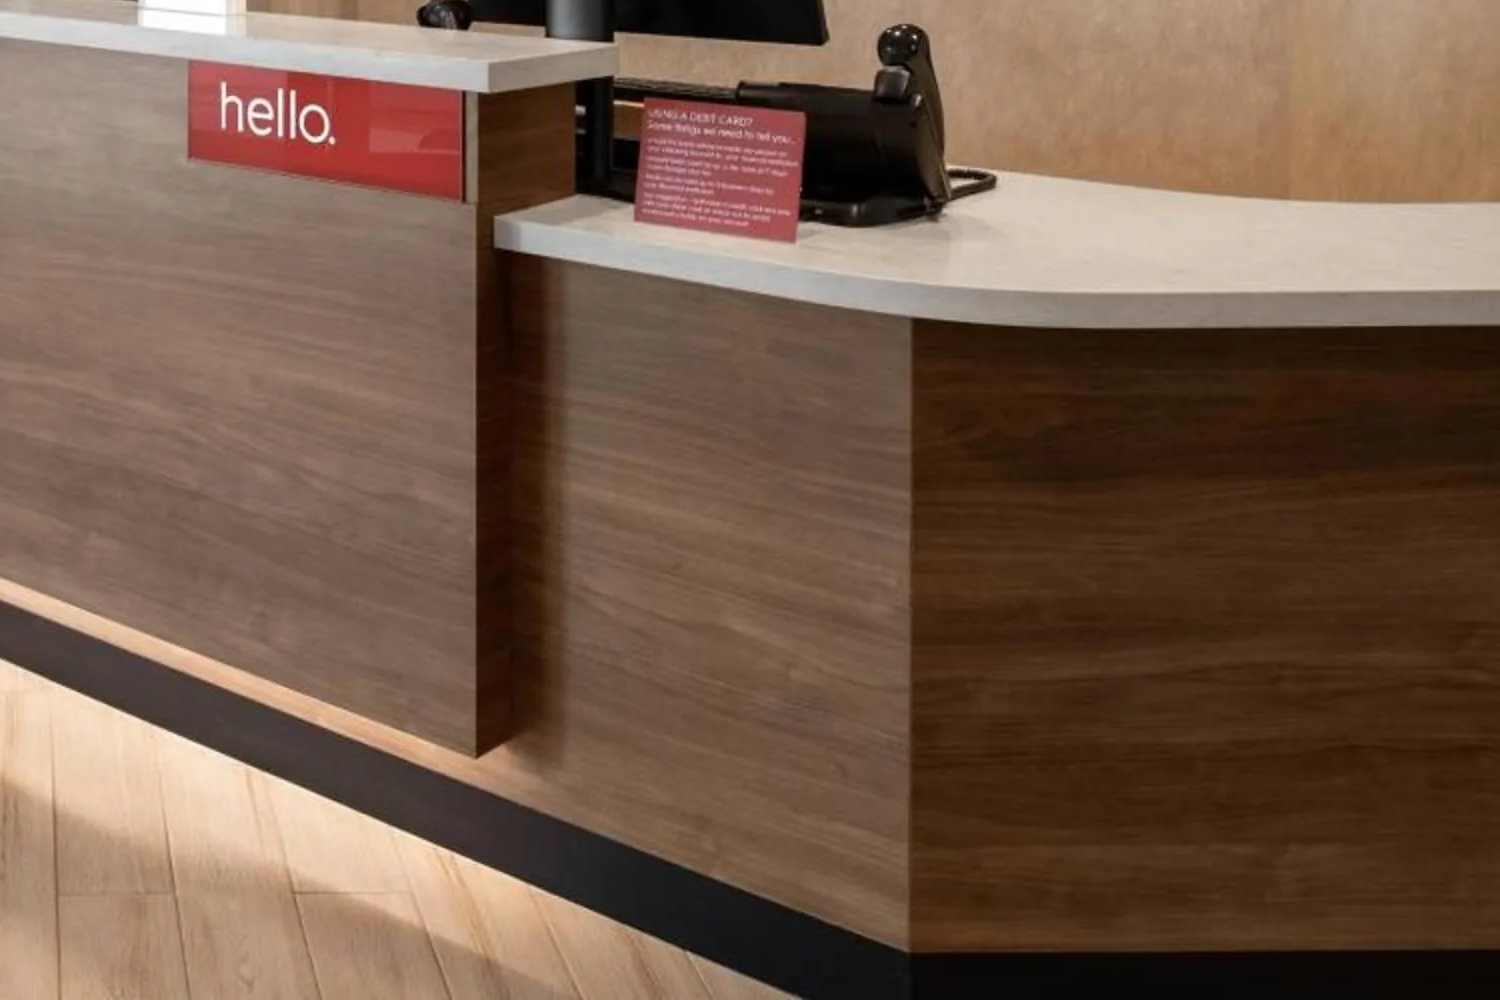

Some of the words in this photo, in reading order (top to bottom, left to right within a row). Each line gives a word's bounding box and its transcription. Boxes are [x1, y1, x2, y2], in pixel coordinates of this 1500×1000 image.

[219, 81, 336, 145] hello.
[680, 112, 688, 121] A
[718, 115, 754, 127] CARD?
[647, 120, 673, 132] Some
[718, 127, 743, 139] need
